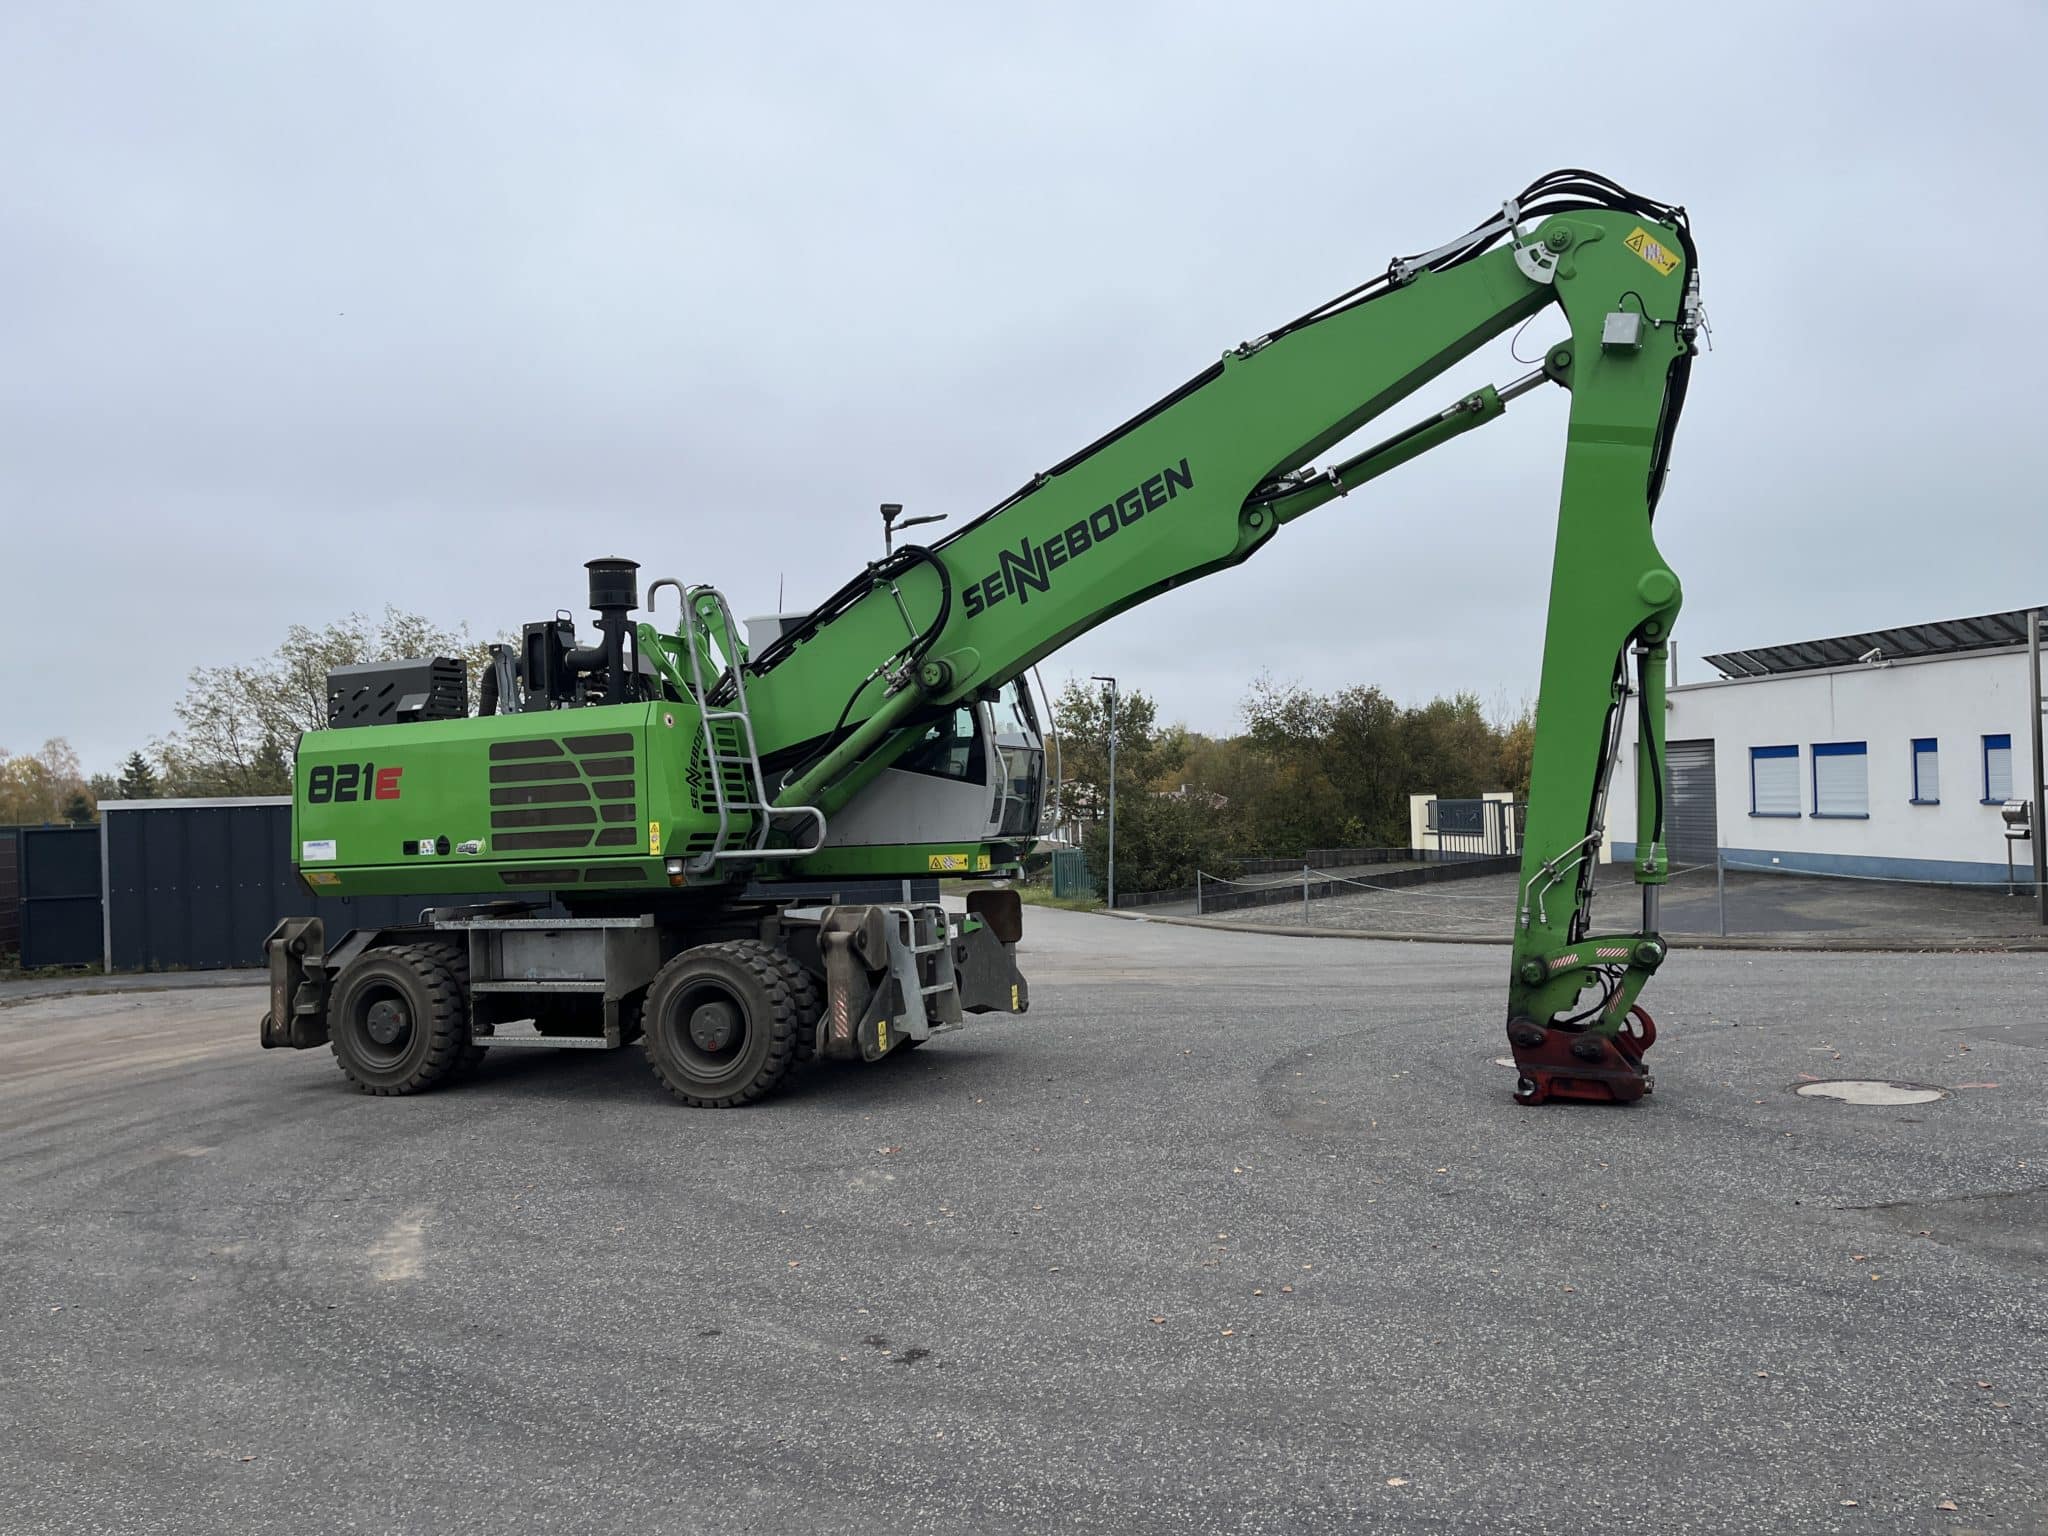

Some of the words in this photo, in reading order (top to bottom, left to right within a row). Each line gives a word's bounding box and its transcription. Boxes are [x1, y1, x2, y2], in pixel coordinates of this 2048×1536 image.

[962, 457, 1194, 620] SENNEBOGEN
[308, 762, 403, 804] 821E
[685, 719, 705, 810] SENNEBOG
